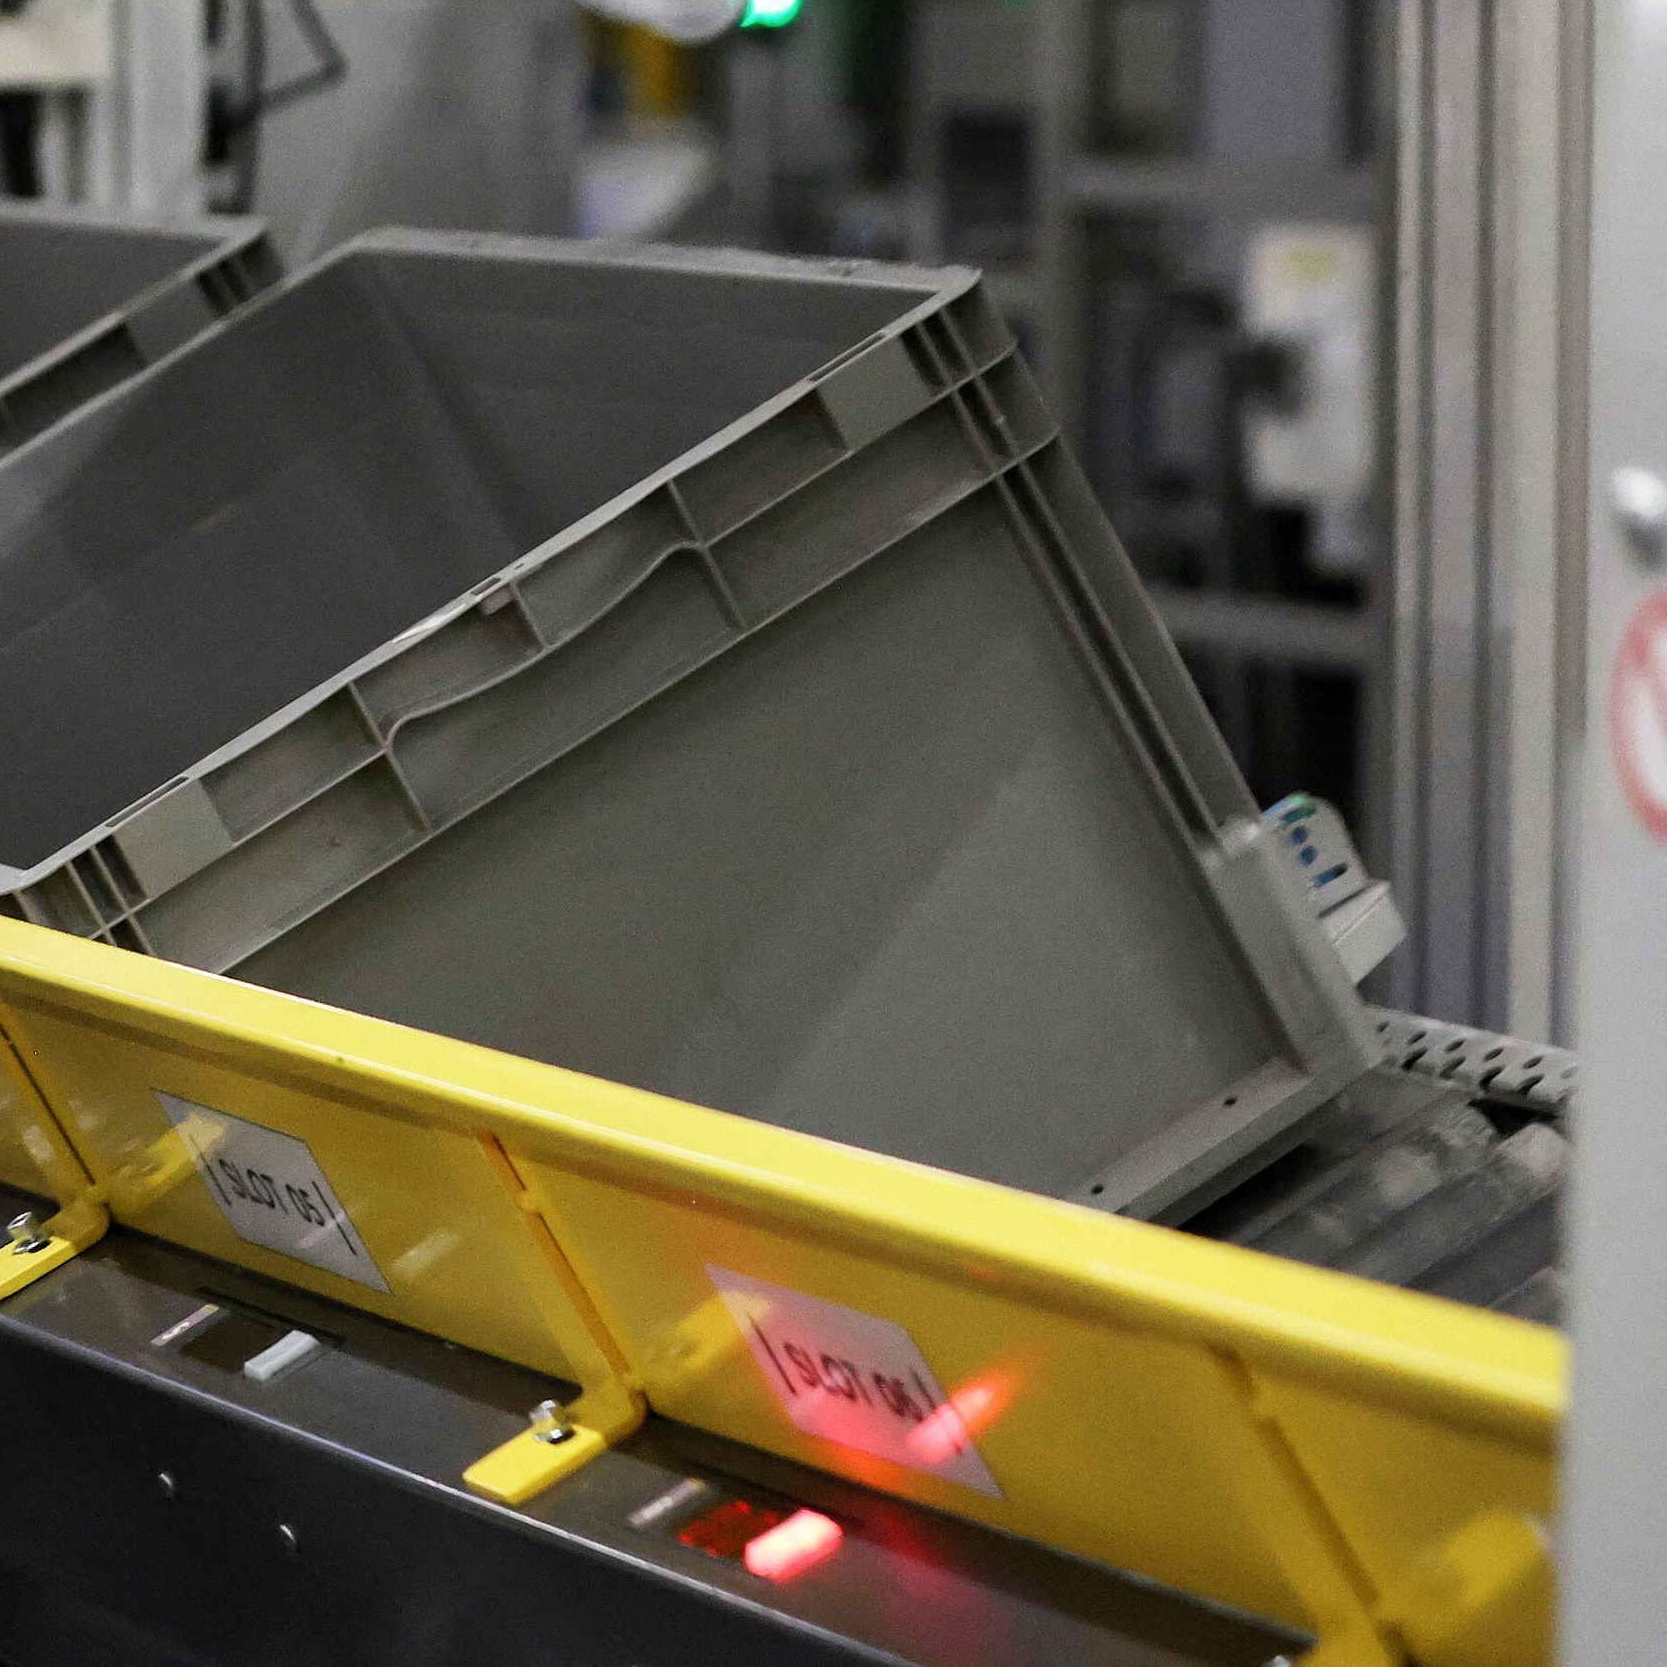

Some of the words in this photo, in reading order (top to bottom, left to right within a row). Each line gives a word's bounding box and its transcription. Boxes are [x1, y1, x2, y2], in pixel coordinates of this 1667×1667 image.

[217, 1158, 289, 1215] SLOT
[285, 1183, 326, 1227] 05
[781, 1340, 873, 1406] SLOT
